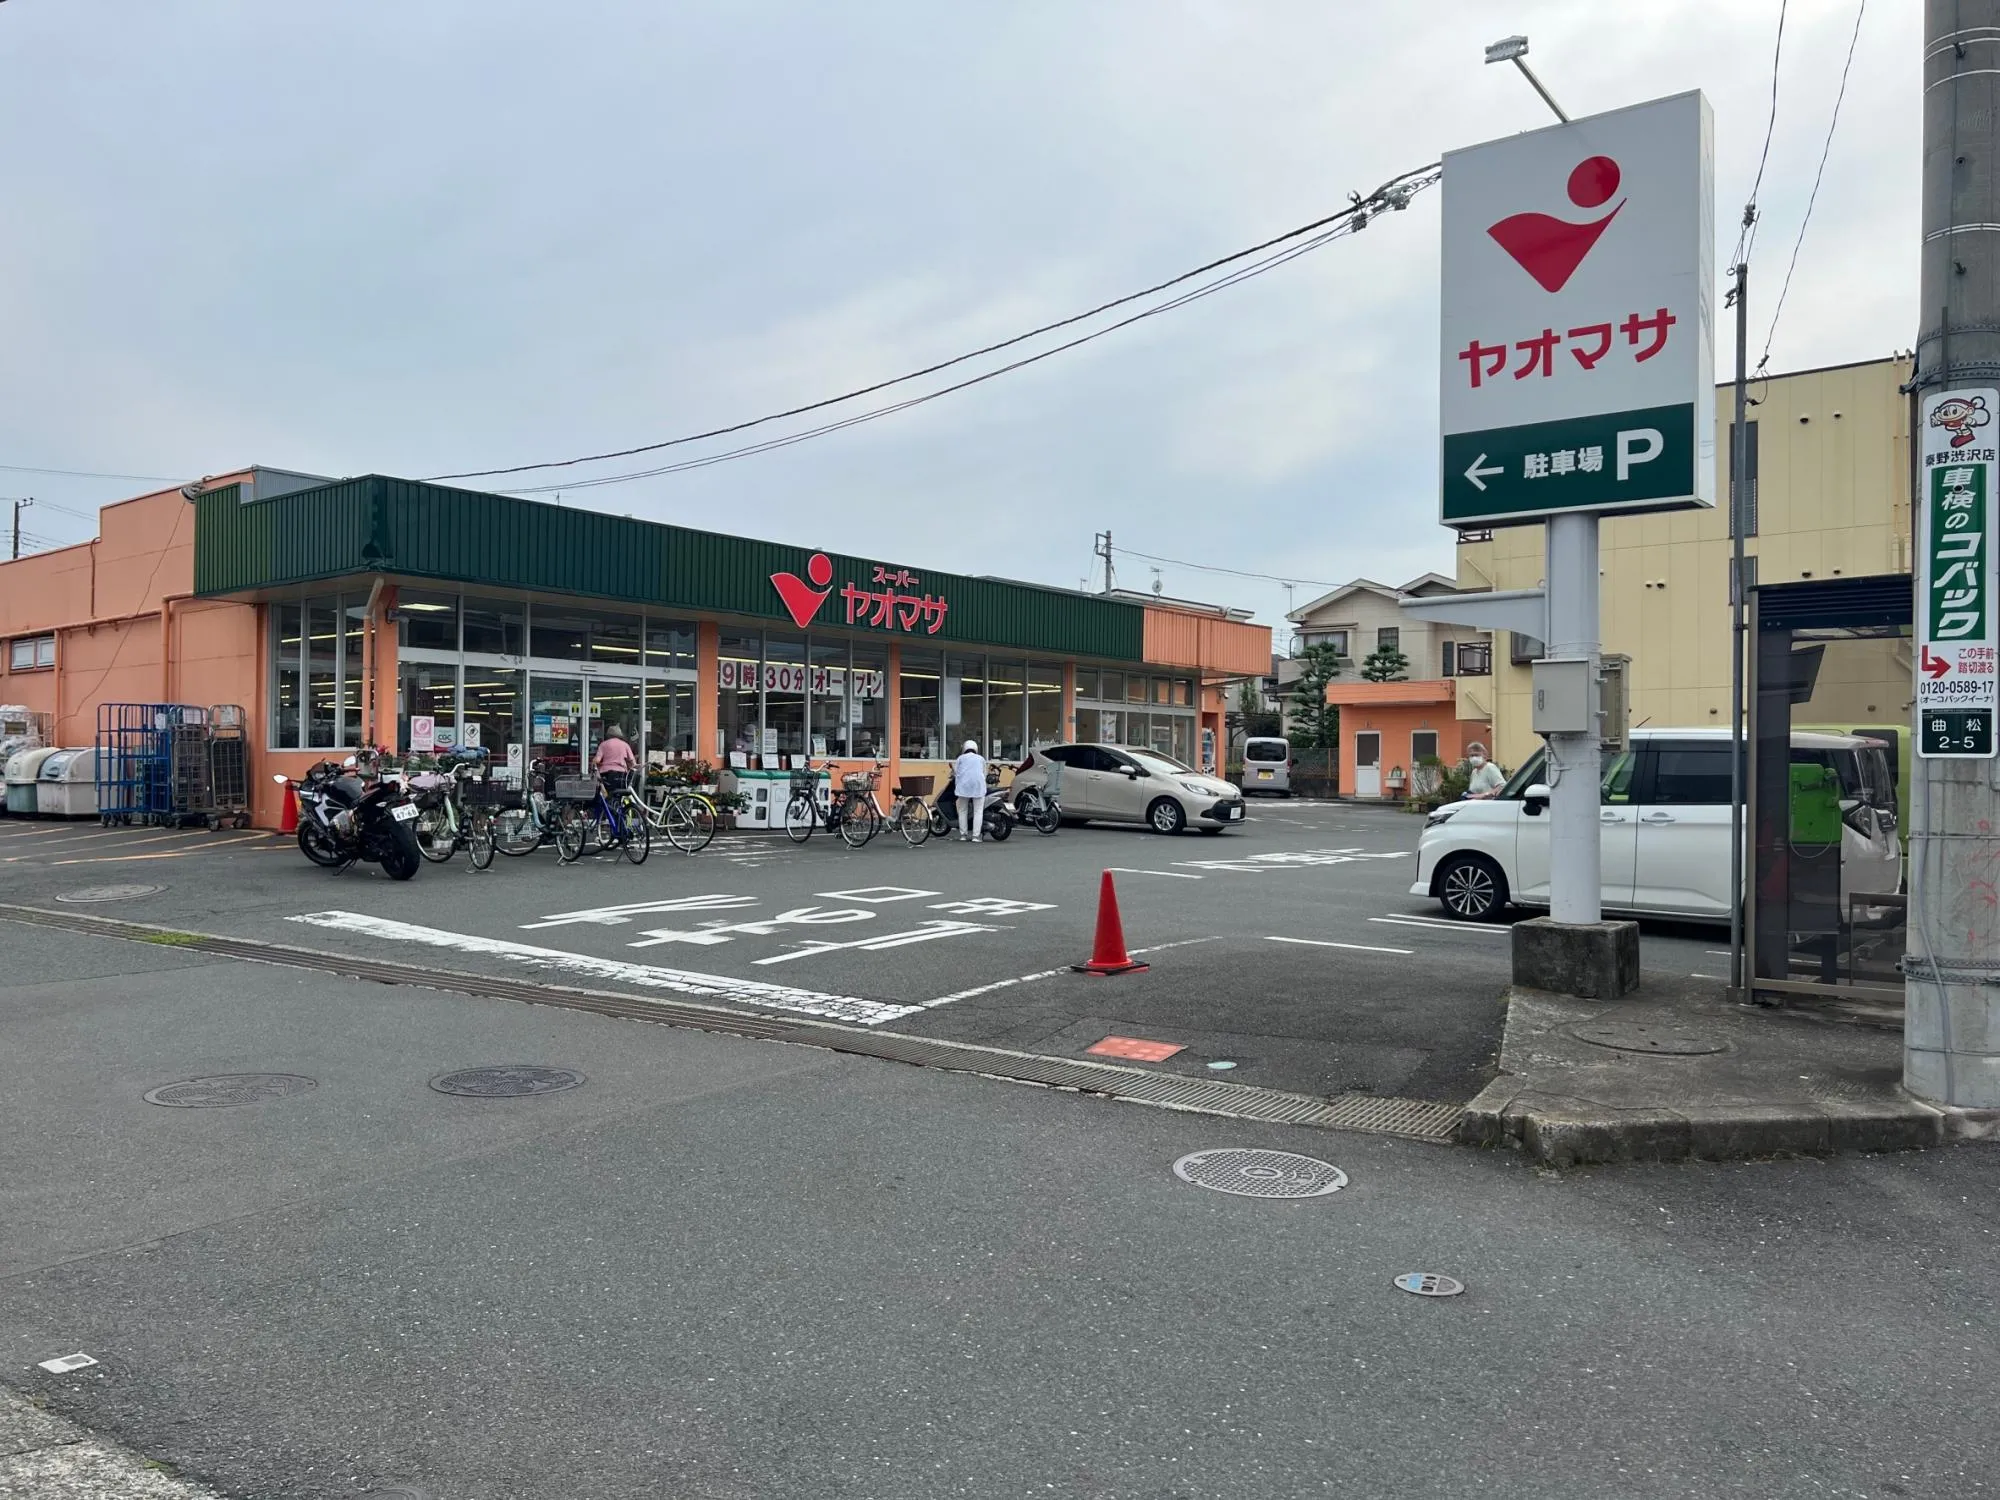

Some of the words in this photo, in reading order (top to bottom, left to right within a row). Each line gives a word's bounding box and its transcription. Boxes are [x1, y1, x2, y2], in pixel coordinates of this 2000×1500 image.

[1458, 307, 1676, 388] ヤオマサ
[1523, 445, 1604, 479] 駐車場
[1616, 428, 1664, 481] P
[1925, 448, 1996, 467] 秦野渋沢店
[1933, 467, 1983, 638] 車検のコバック
[872, 566, 920, 588] スーパー
[840, 582, 948, 635] ヤオマサ
[1958, 647, 1995, 660] この手前
[1957, 661, 1995, 674] 踏切渡る
[1920, 681, 1994, 695] 0120-0589-17
[1938, 735, 1975, 749] 2-5
